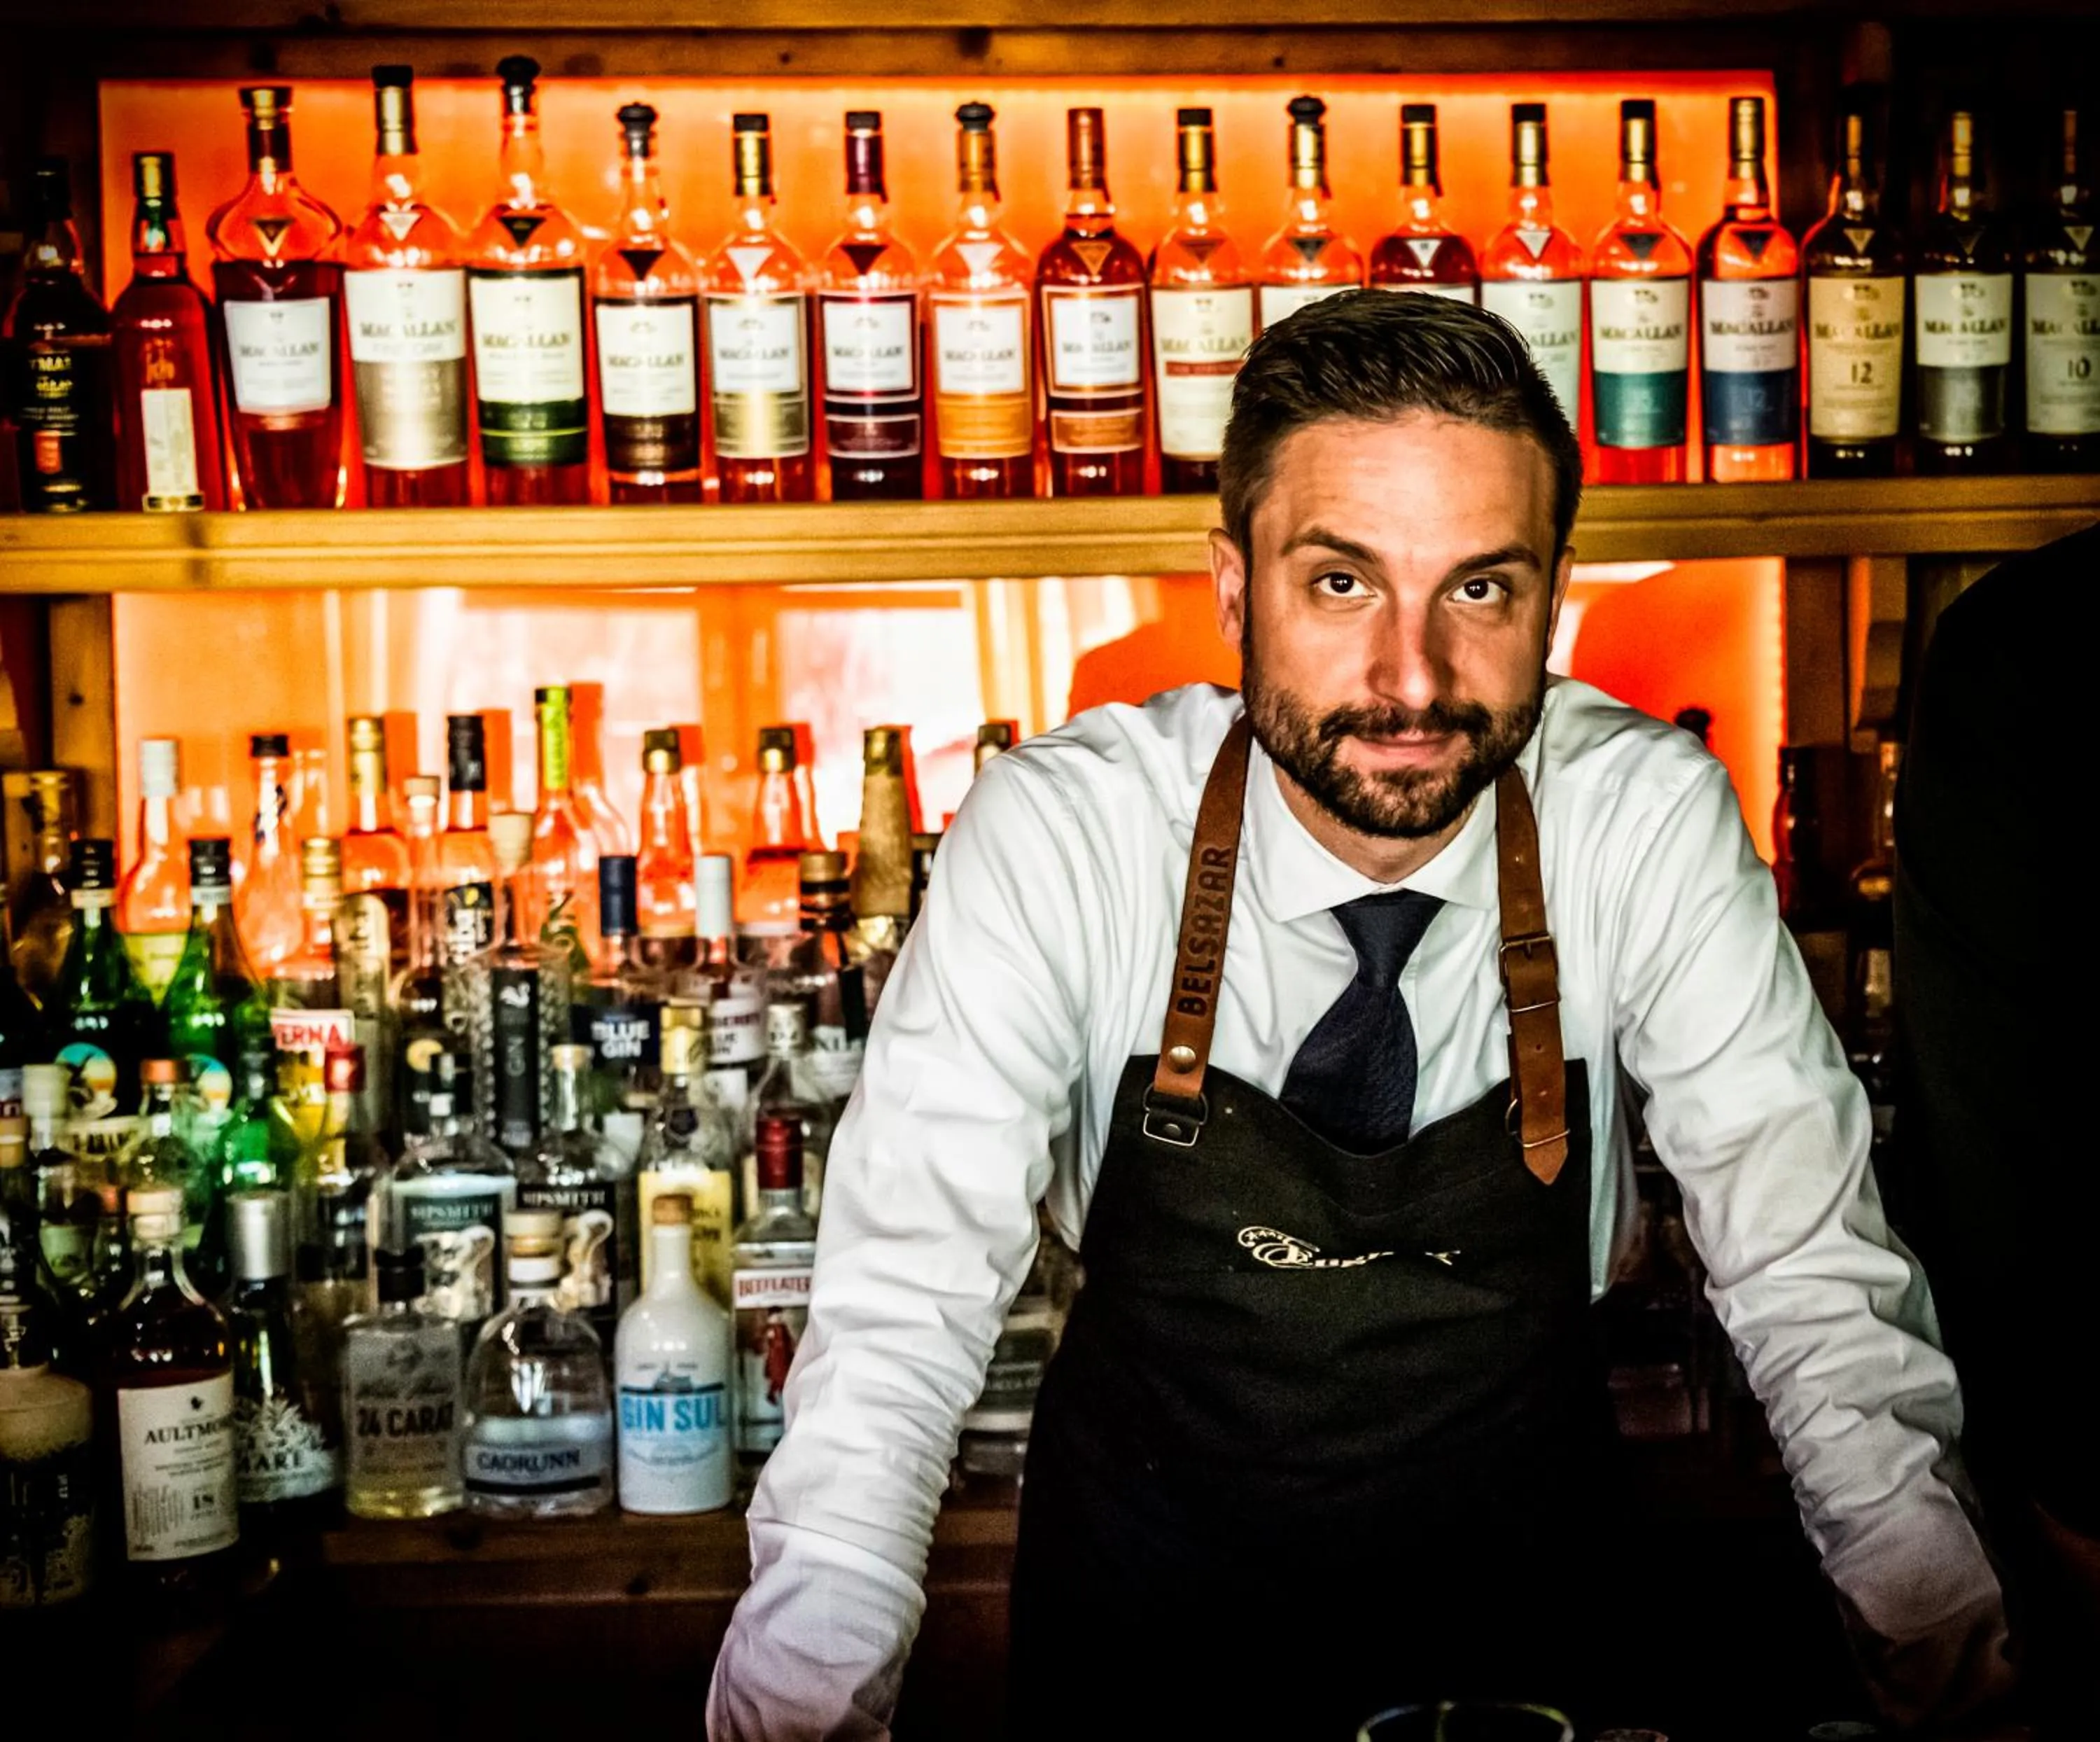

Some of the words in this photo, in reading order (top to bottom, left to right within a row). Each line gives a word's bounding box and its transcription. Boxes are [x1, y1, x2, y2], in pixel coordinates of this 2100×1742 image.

[360, 319, 456, 338] MACLLAN
[1814, 322, 1900, 340] MAALLAN
[482, 333, 570, 348] MACLLAN
[1062, 340, 1130, 354] MAALLAN
[719, 347, 788, 360] MACLLAN
[832, 345, 903, 358] MACLLAN
[945, 347, 1014, 361] MACLLAN
[608, 354, 685, 368] MACLLAN
[2067, 358, 2092, 380] 10
[1849, 361, 1872, 384] 12
[1176, 845, 1232, 1018] BELSAZAR
[591, 1019, 650, 1040] BLUE
[602, 1040, 642, 1059] GIN
[620, 1395, 666, 1431] GIN
